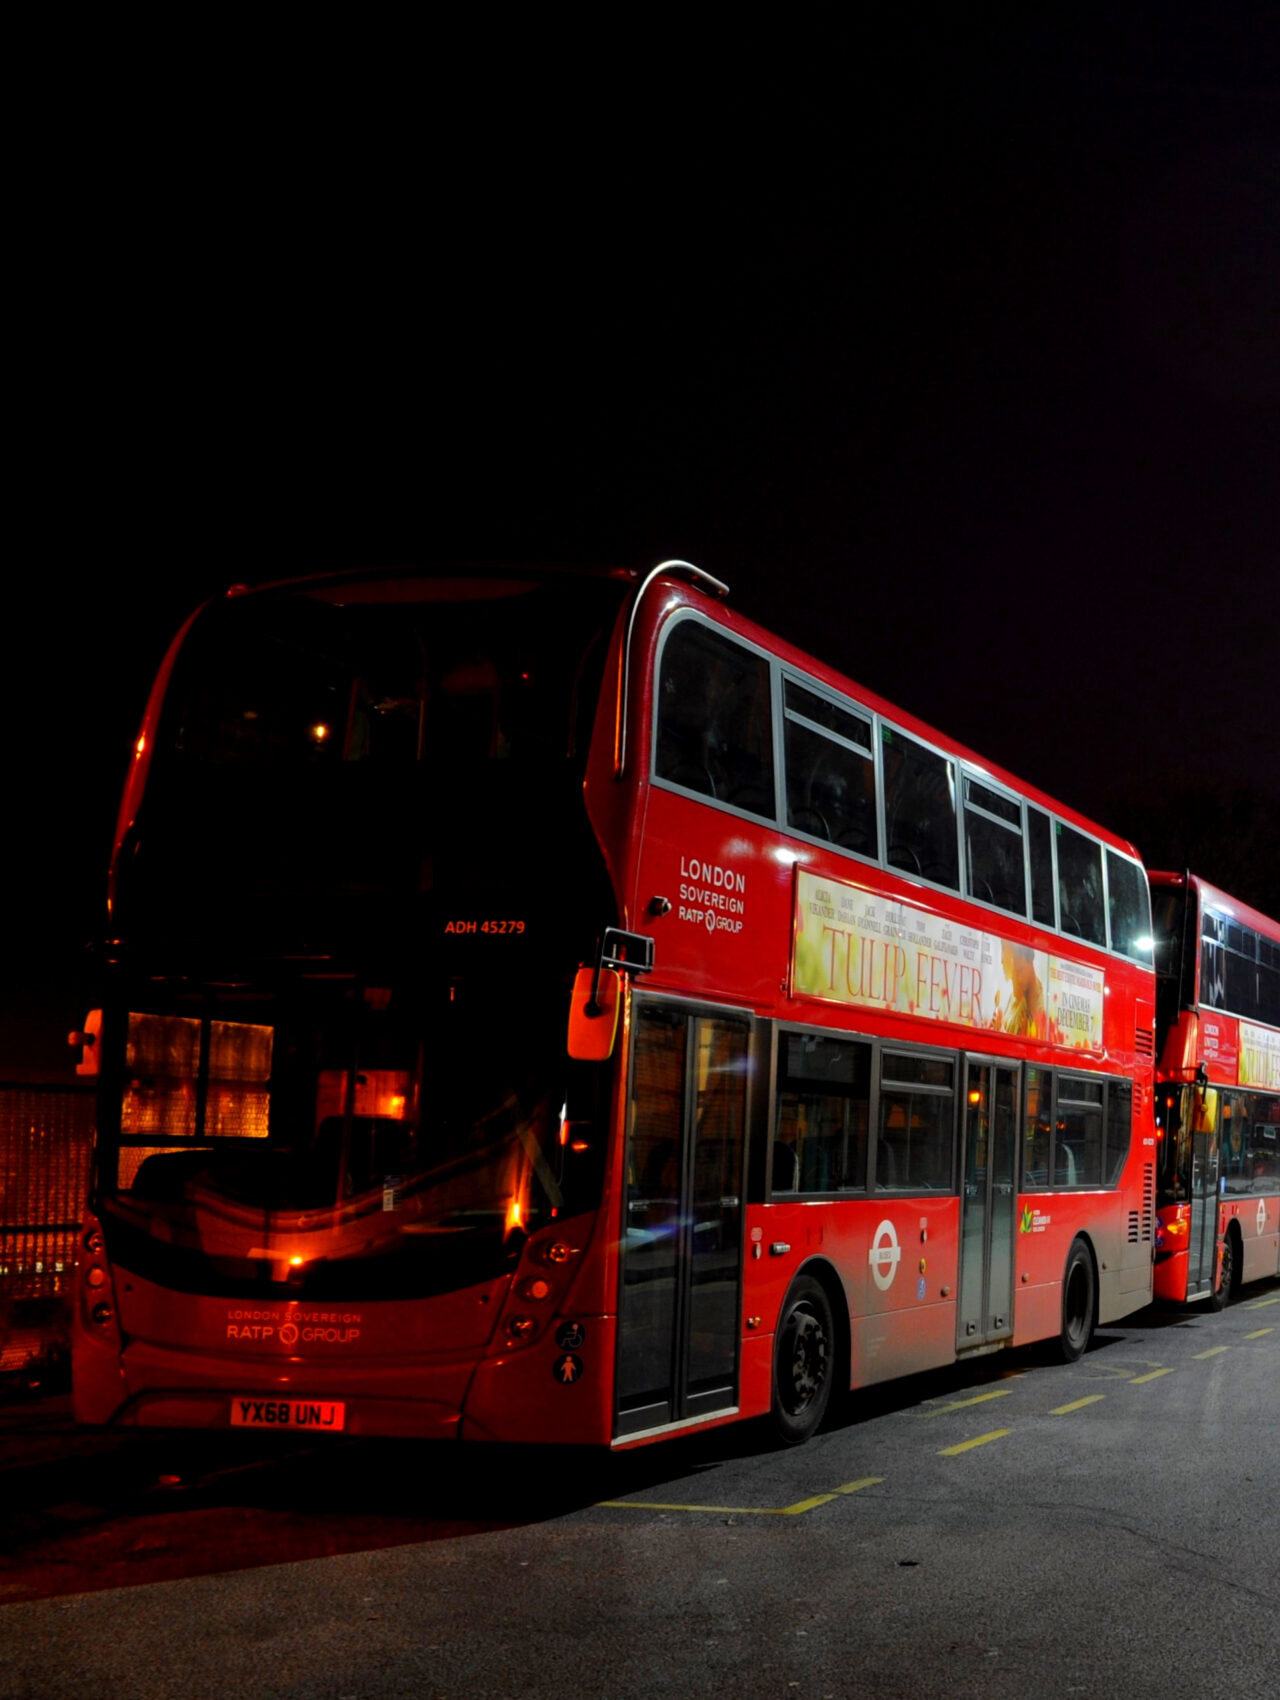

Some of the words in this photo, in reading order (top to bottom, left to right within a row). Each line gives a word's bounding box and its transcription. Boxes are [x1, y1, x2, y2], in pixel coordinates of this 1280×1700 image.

[680, 855, 746, 893] LONDON
[679, 883, 744, 915] SOVEREIGN
[444, 920, 478, 934] ADH
[480, 920, 526, 934] 45279
[678, 905, 705, 924] RATP
[716, 916, 743, 933] GROUP
[823, 925, 907, 1004] TULIP
[915, 952, 983, 1022] FEVER
[1057, 1007, 1090, 1033] DECEMBER
[228, 1310, 280, 1321] LONDON
[284, 1311, 361, 1323] SOVEREIGN
[226, 1324, 274, 1340] RATP
[301, 1328, 361, 1343] GROUP
[240, 1401, 290, 1424] YX68
[295, 1405, 335, 1426] UNJ
